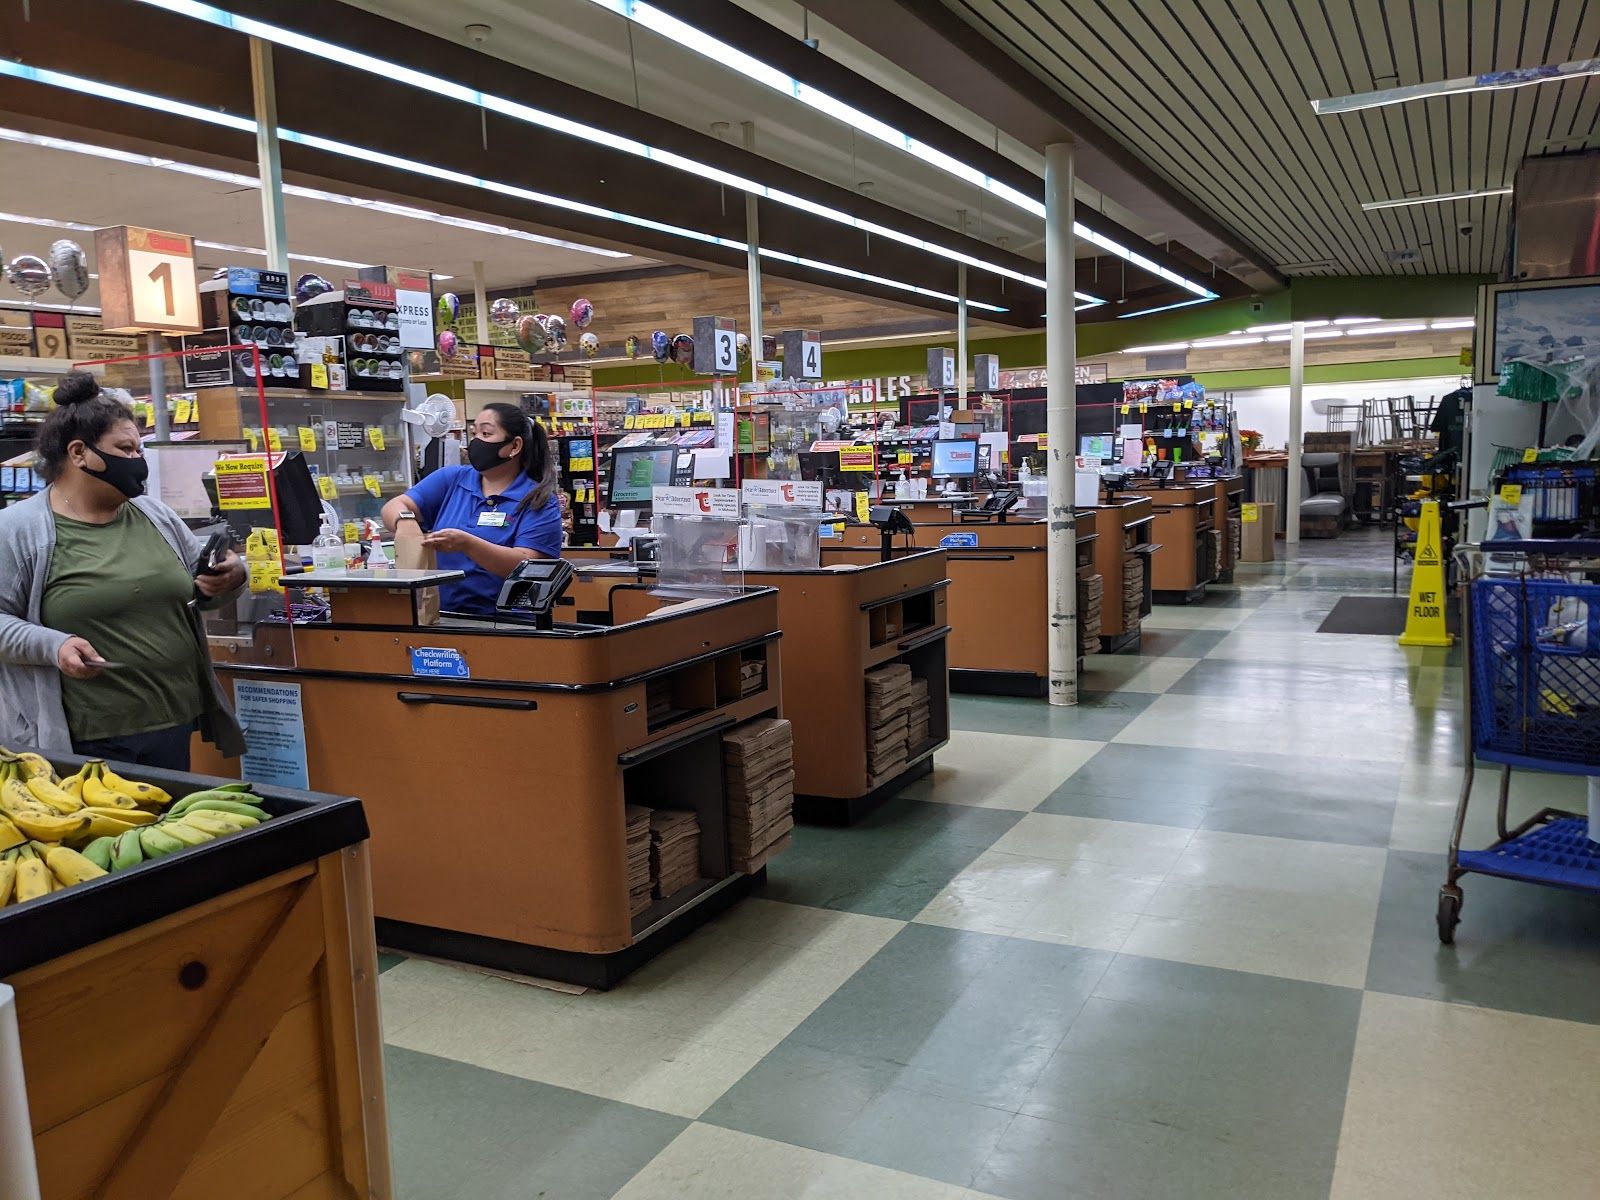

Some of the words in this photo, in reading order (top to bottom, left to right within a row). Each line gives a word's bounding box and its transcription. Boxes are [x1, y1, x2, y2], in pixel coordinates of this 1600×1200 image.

[148, 262, 175, 316] 1
[397, 304, 430, 317] XPRESS
[44, 335, 60, 359] 9
[720, 334, 732, 366] 3
[806, 345, 817, 373] 4
[481, 361, 493, 377] 11
[945, 359, 953, 382] 5
[990, 365, 997, 386] 6
[1028, 366, 1090, 382] GAEN
[239, 461, 263, 472] Require
[1418, 592, 1436, 602] WET
[1414, 606, 1440, 617] FLOOR
[423, 659, 452, 668] Platform
[237, 685, 298, 698] RECOMMENDATIONS
[268, 697, 297, 706] SHOPPING
